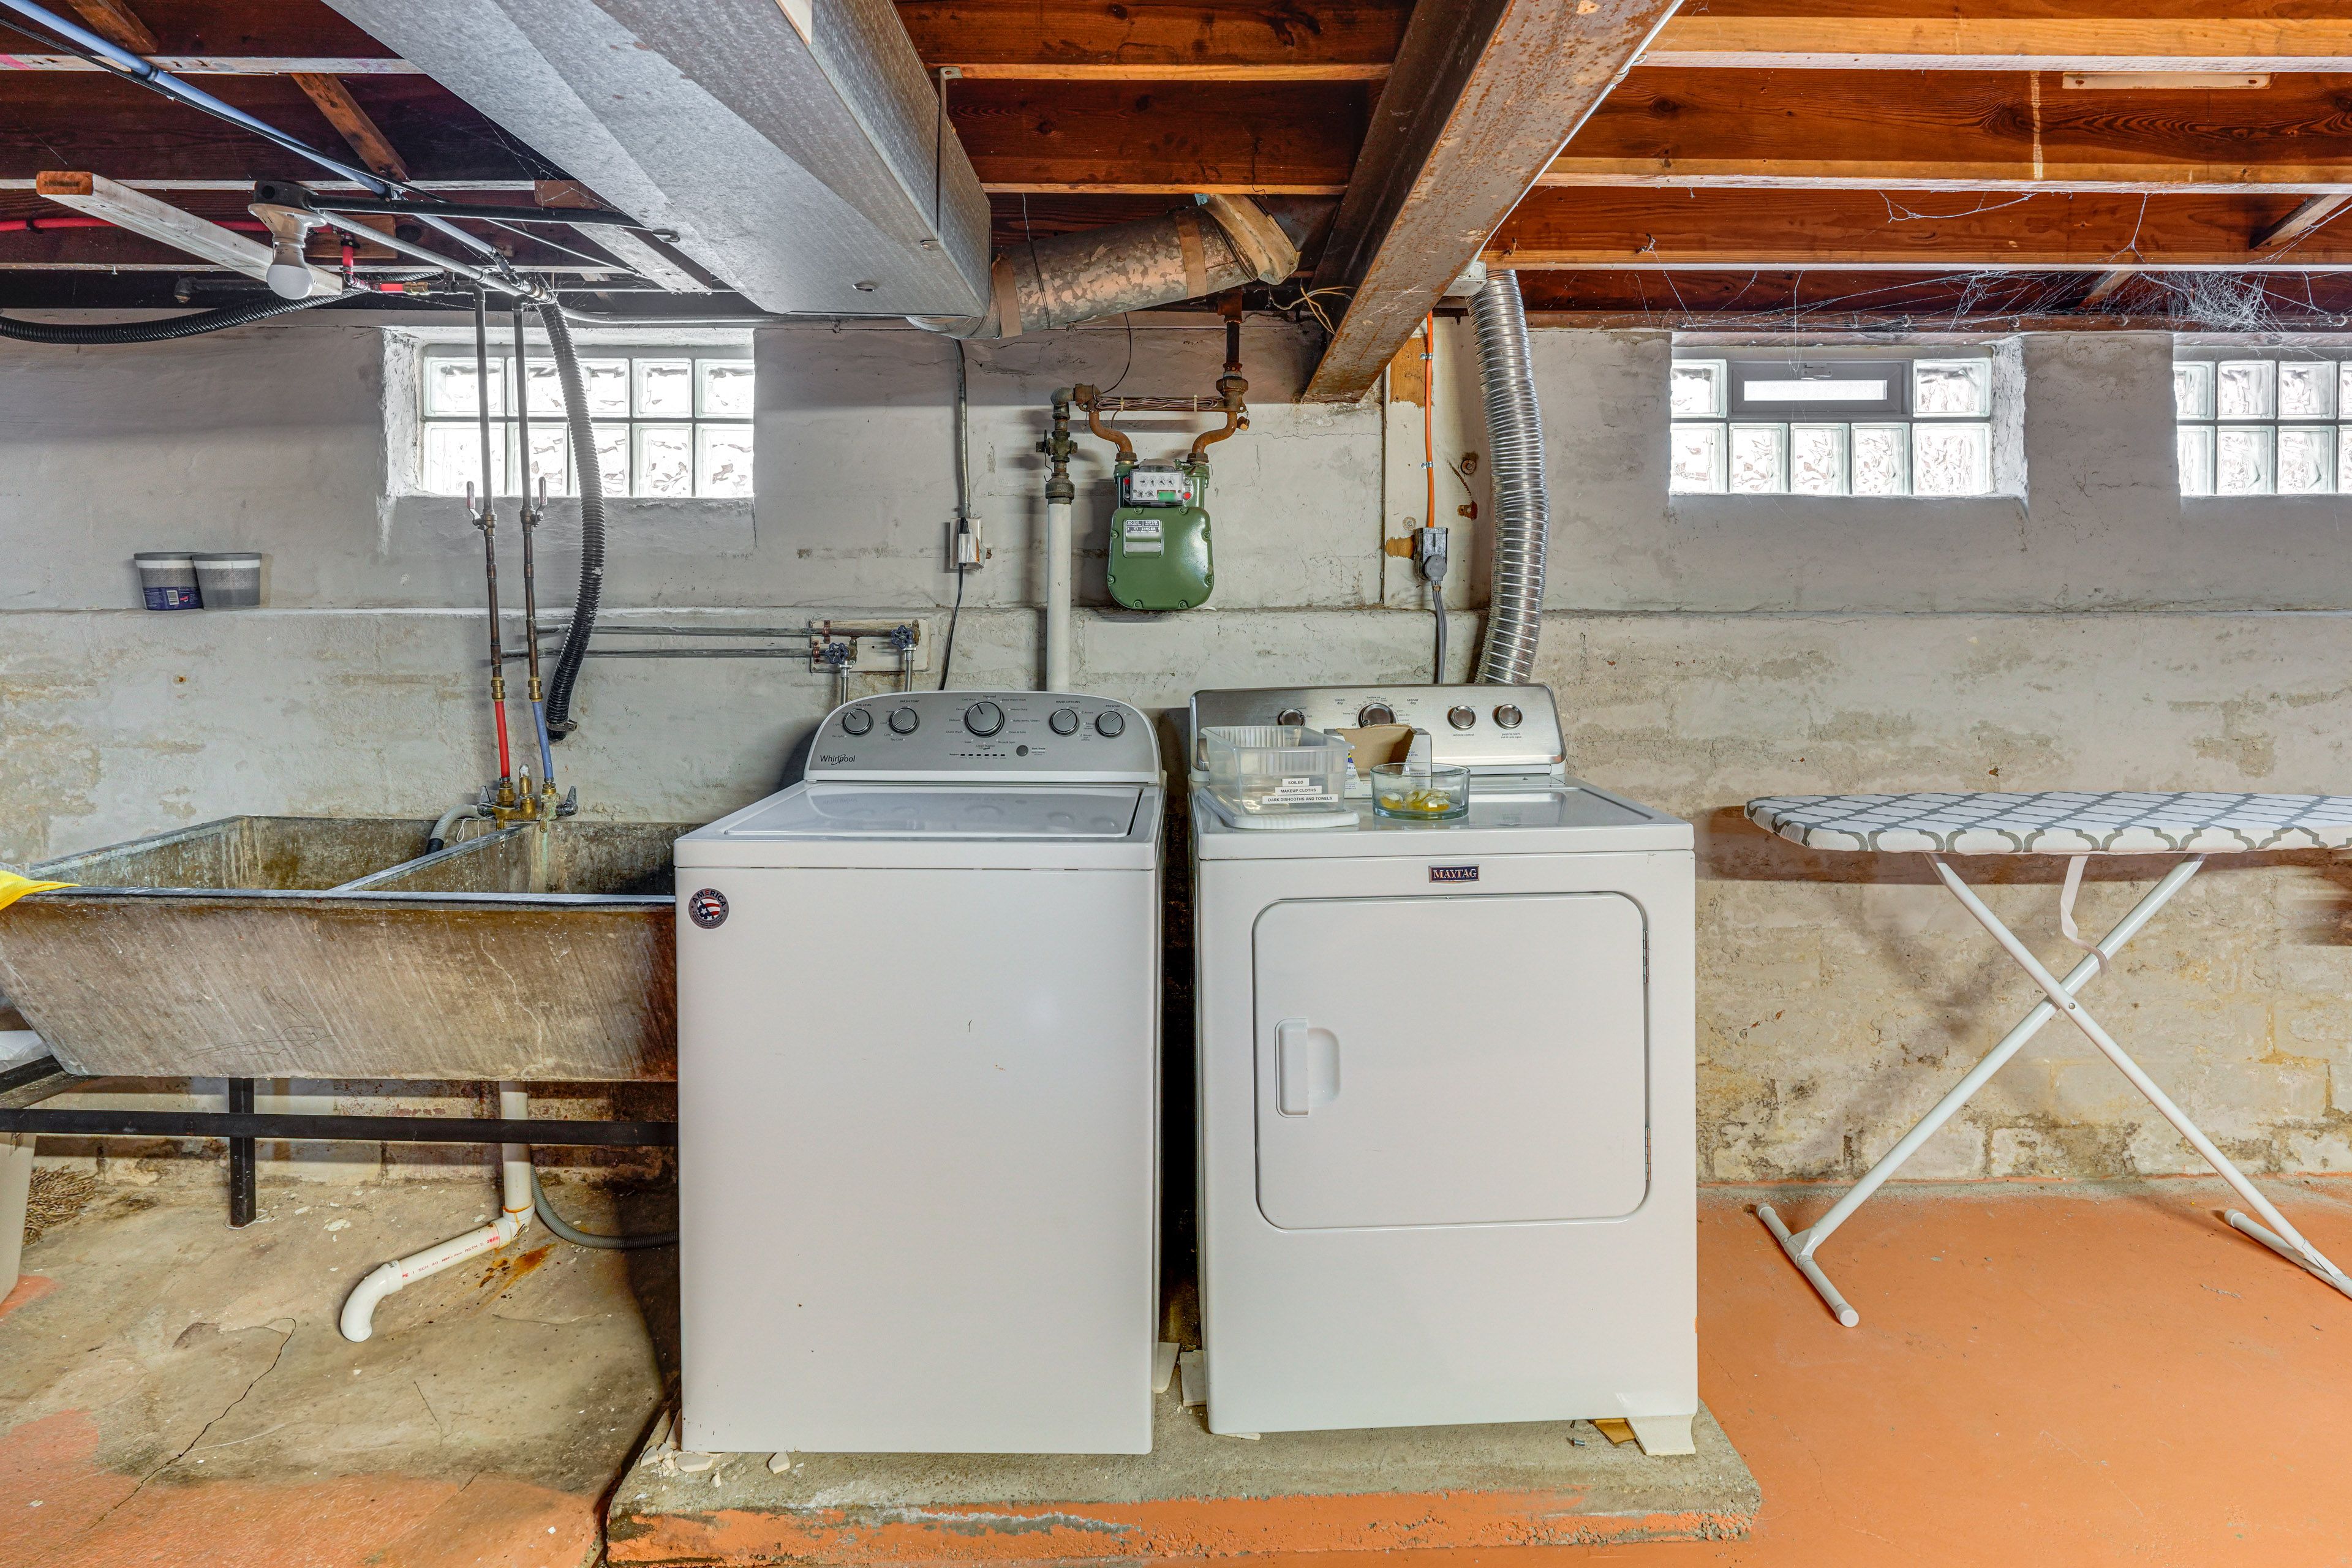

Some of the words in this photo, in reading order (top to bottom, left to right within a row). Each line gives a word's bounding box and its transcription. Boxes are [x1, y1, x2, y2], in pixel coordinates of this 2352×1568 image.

[820, 754, 856, 765] Whirlpool
[1433, 869, 1477, 879] MAYTAG
[693, 889, 726, 907] AMERICA
